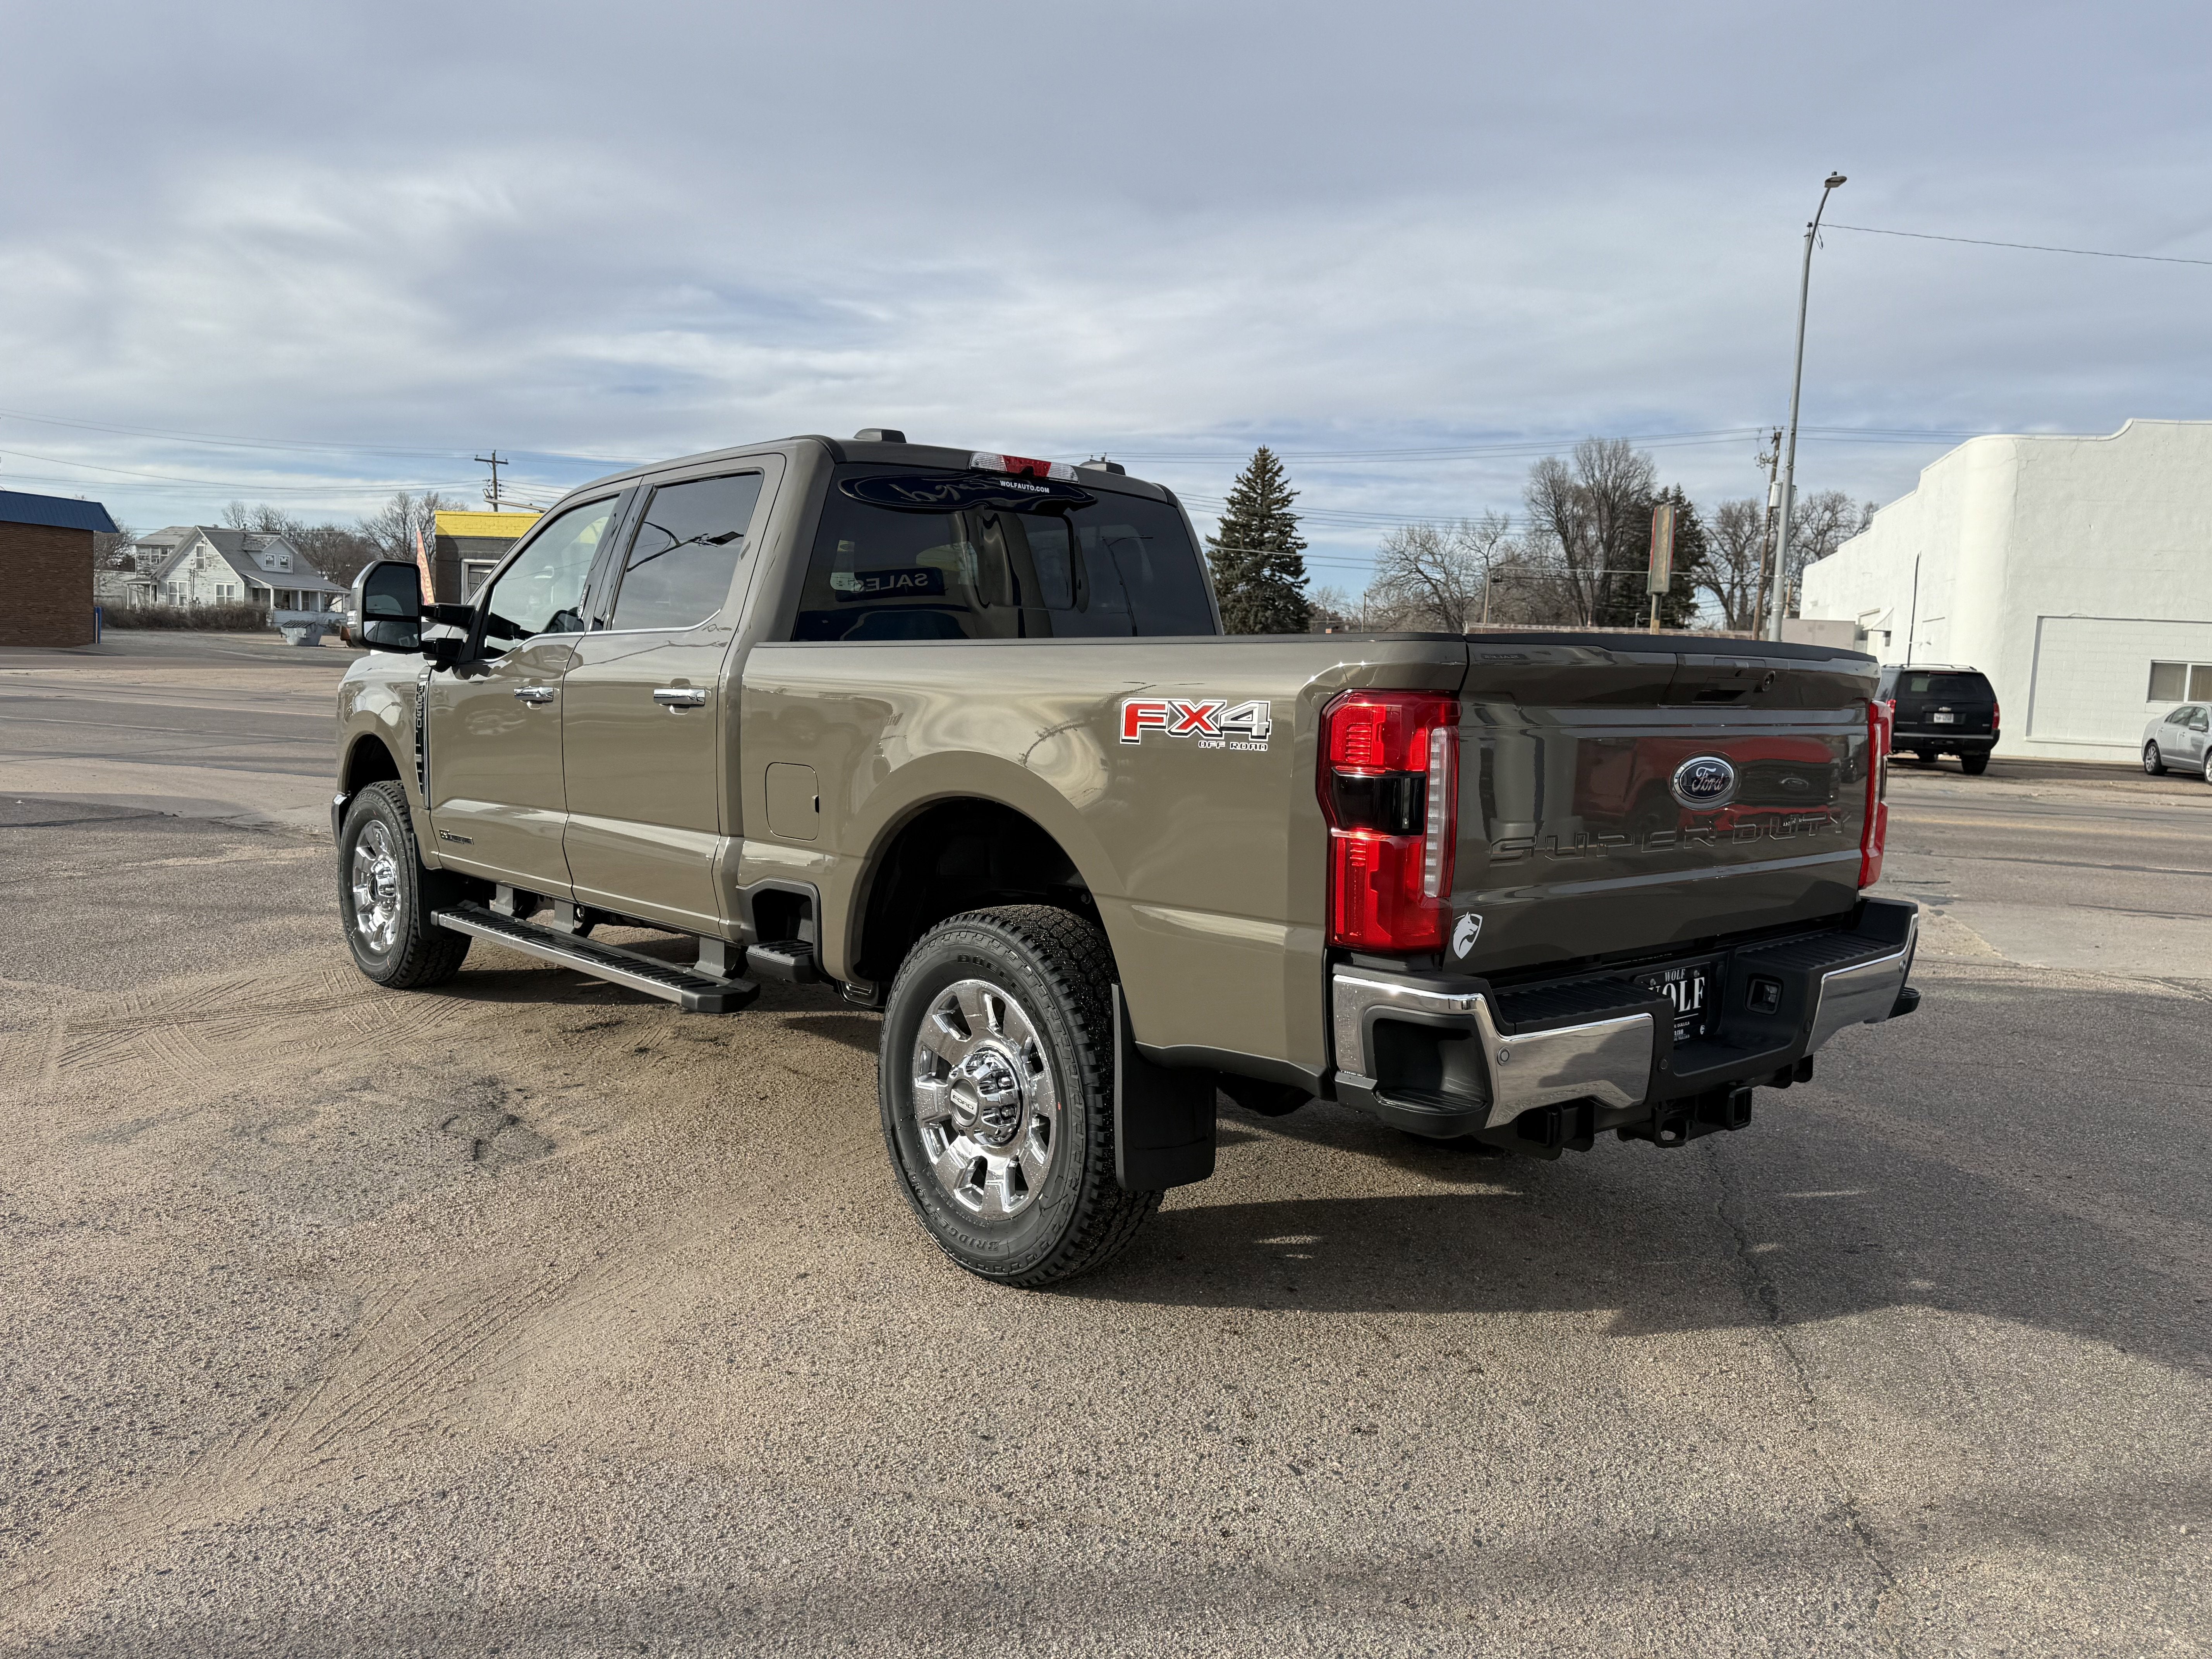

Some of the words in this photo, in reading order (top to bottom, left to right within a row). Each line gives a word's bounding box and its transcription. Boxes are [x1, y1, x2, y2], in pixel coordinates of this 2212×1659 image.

[1000, 480, 1049, 493] WOLFAUTO.COM
[1120, 698, 1272, 745] FX4
[1198, 740, 1225, 749] OFF
[1230, 742, 1268, 752] ROAD
[1692, 767, 1723, 792] Ford
[1489, 824, 1717, 867] SUPER
[1733, 811, 1851, 844] DUTY
[958, 953, 1036, 1015] DUELER
[1665, 969, 1686, 982] WOLF
[1648, 977, 1705, 1012] OLF
[953, 1095, 974, 1110] FORD
[902, 1159, 1001, 1253] BRIDGESTONE
